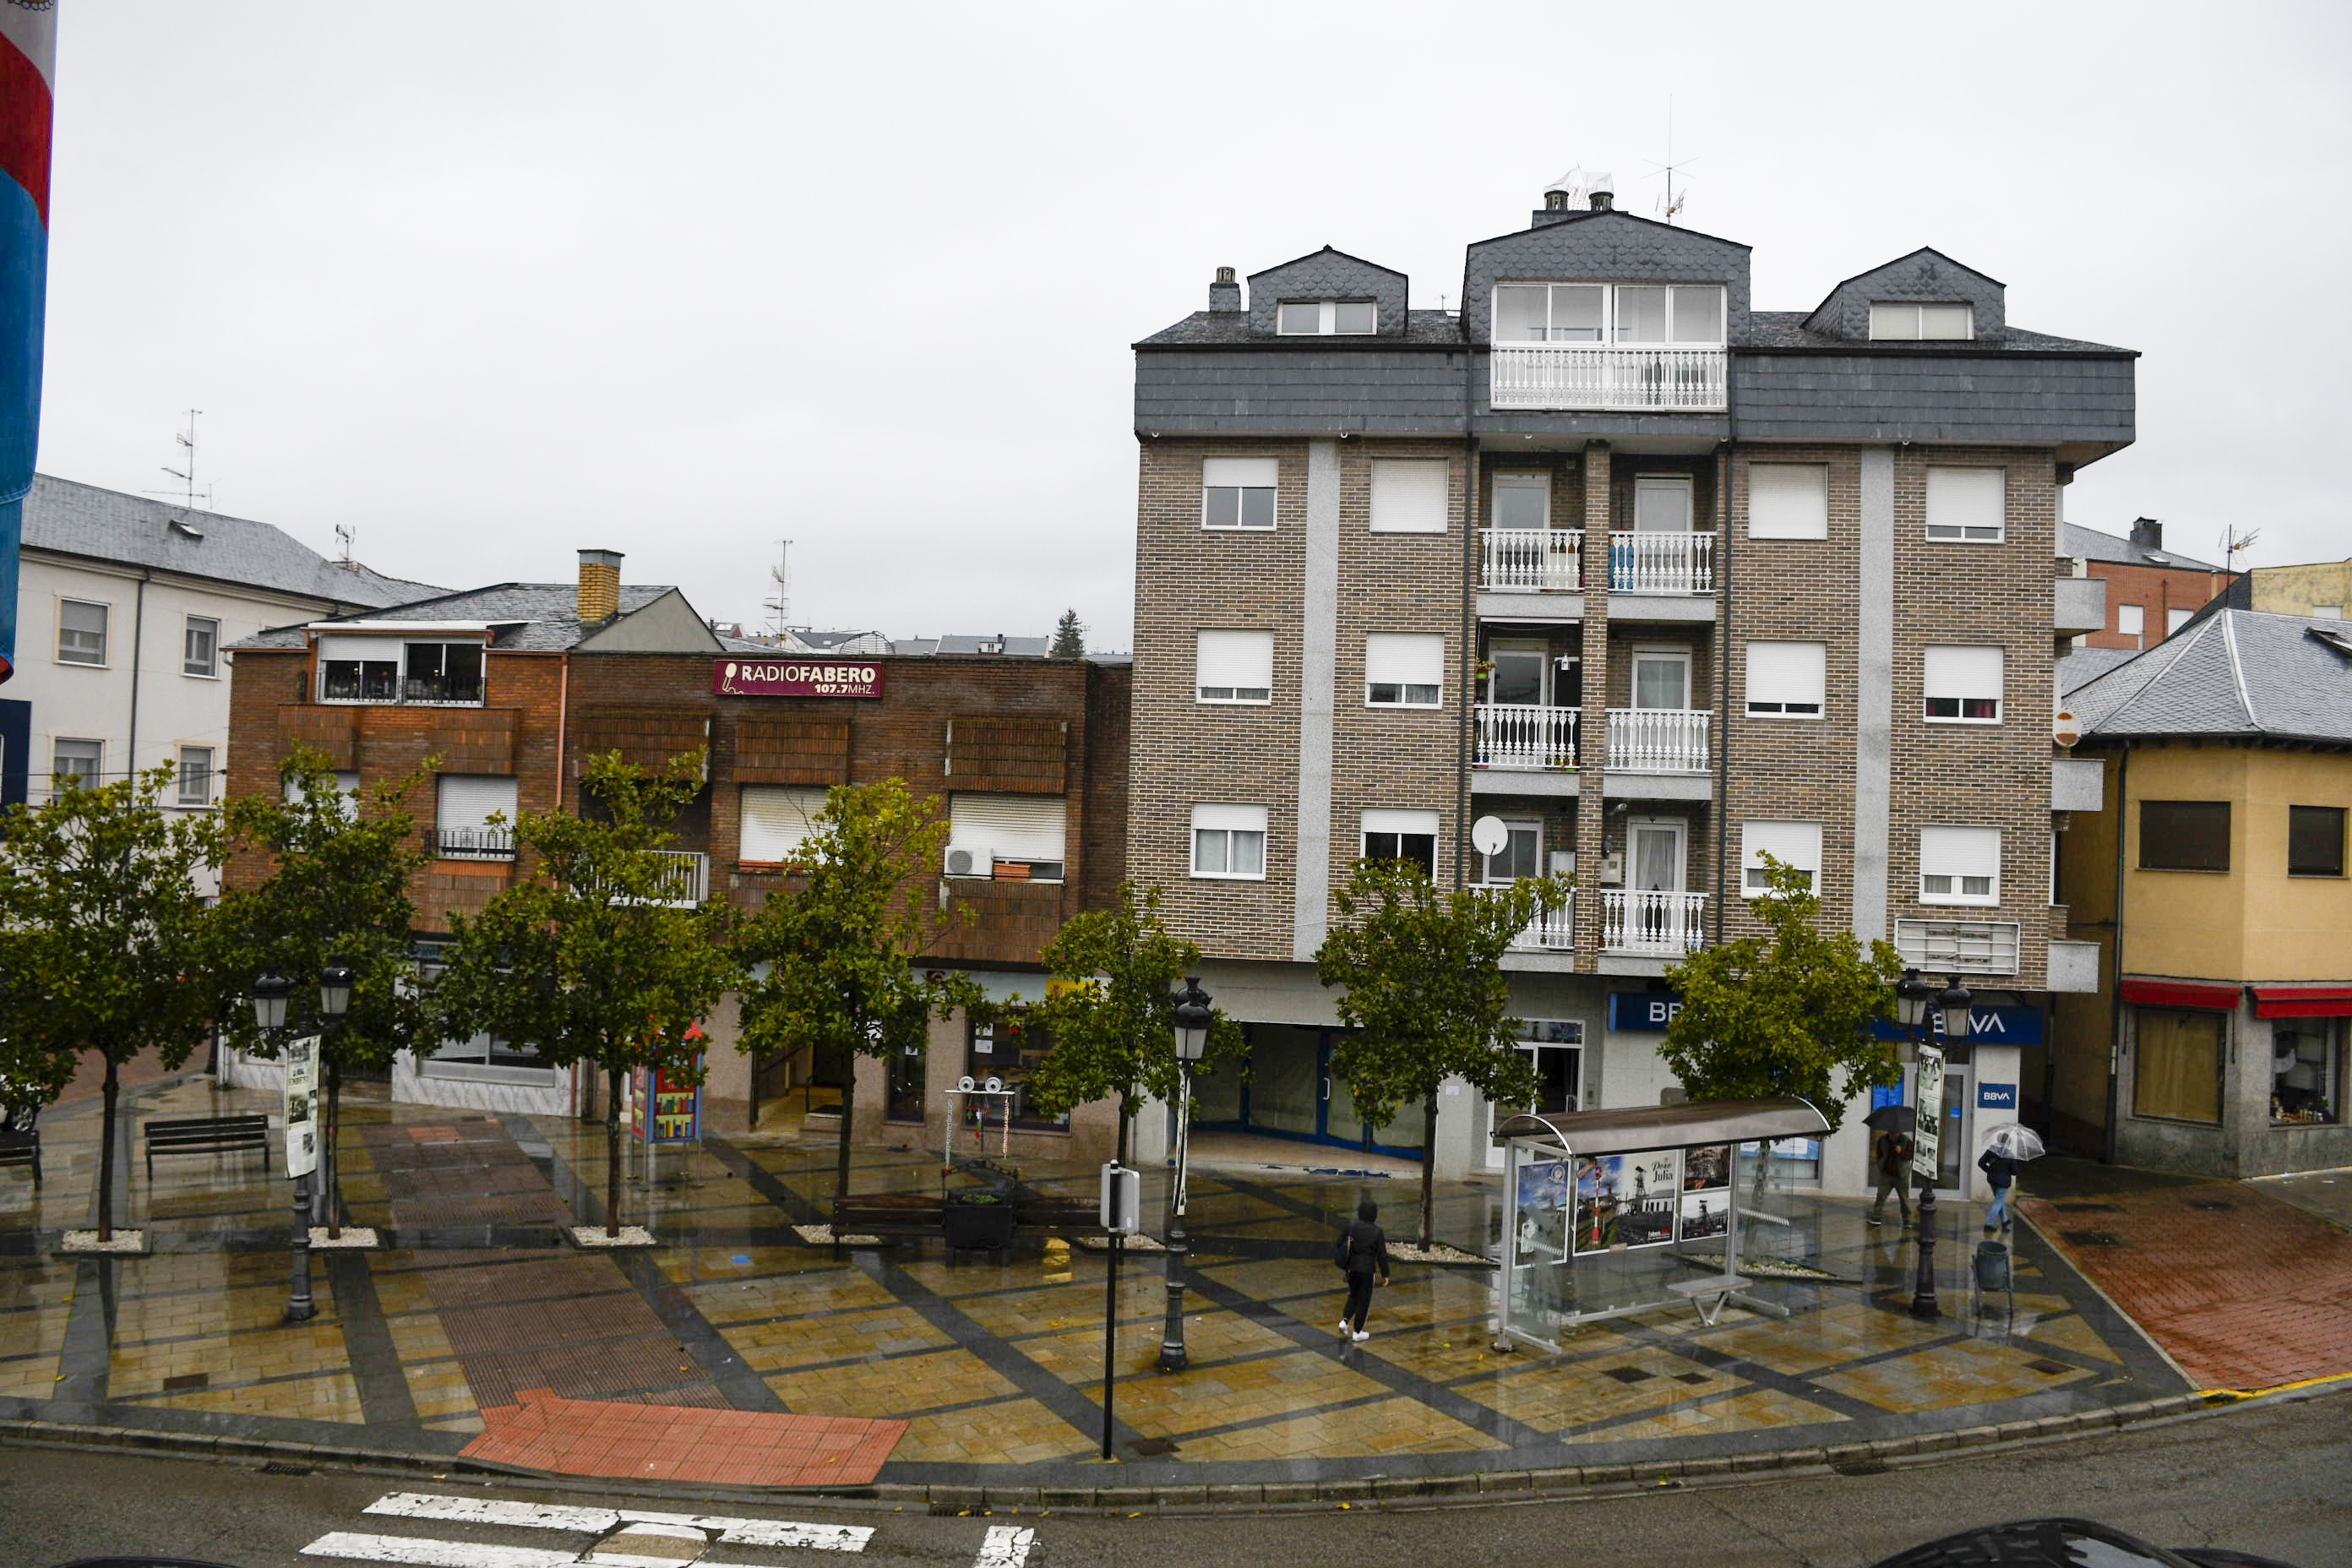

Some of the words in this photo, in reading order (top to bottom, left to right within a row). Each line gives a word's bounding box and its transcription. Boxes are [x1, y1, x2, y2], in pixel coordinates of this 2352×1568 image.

[742, 665, 876, 683] RADIOFABERO
[1983, 1092, 2011, 1101] BBVA
[1652, 1169, 1674, 1183] Julia
